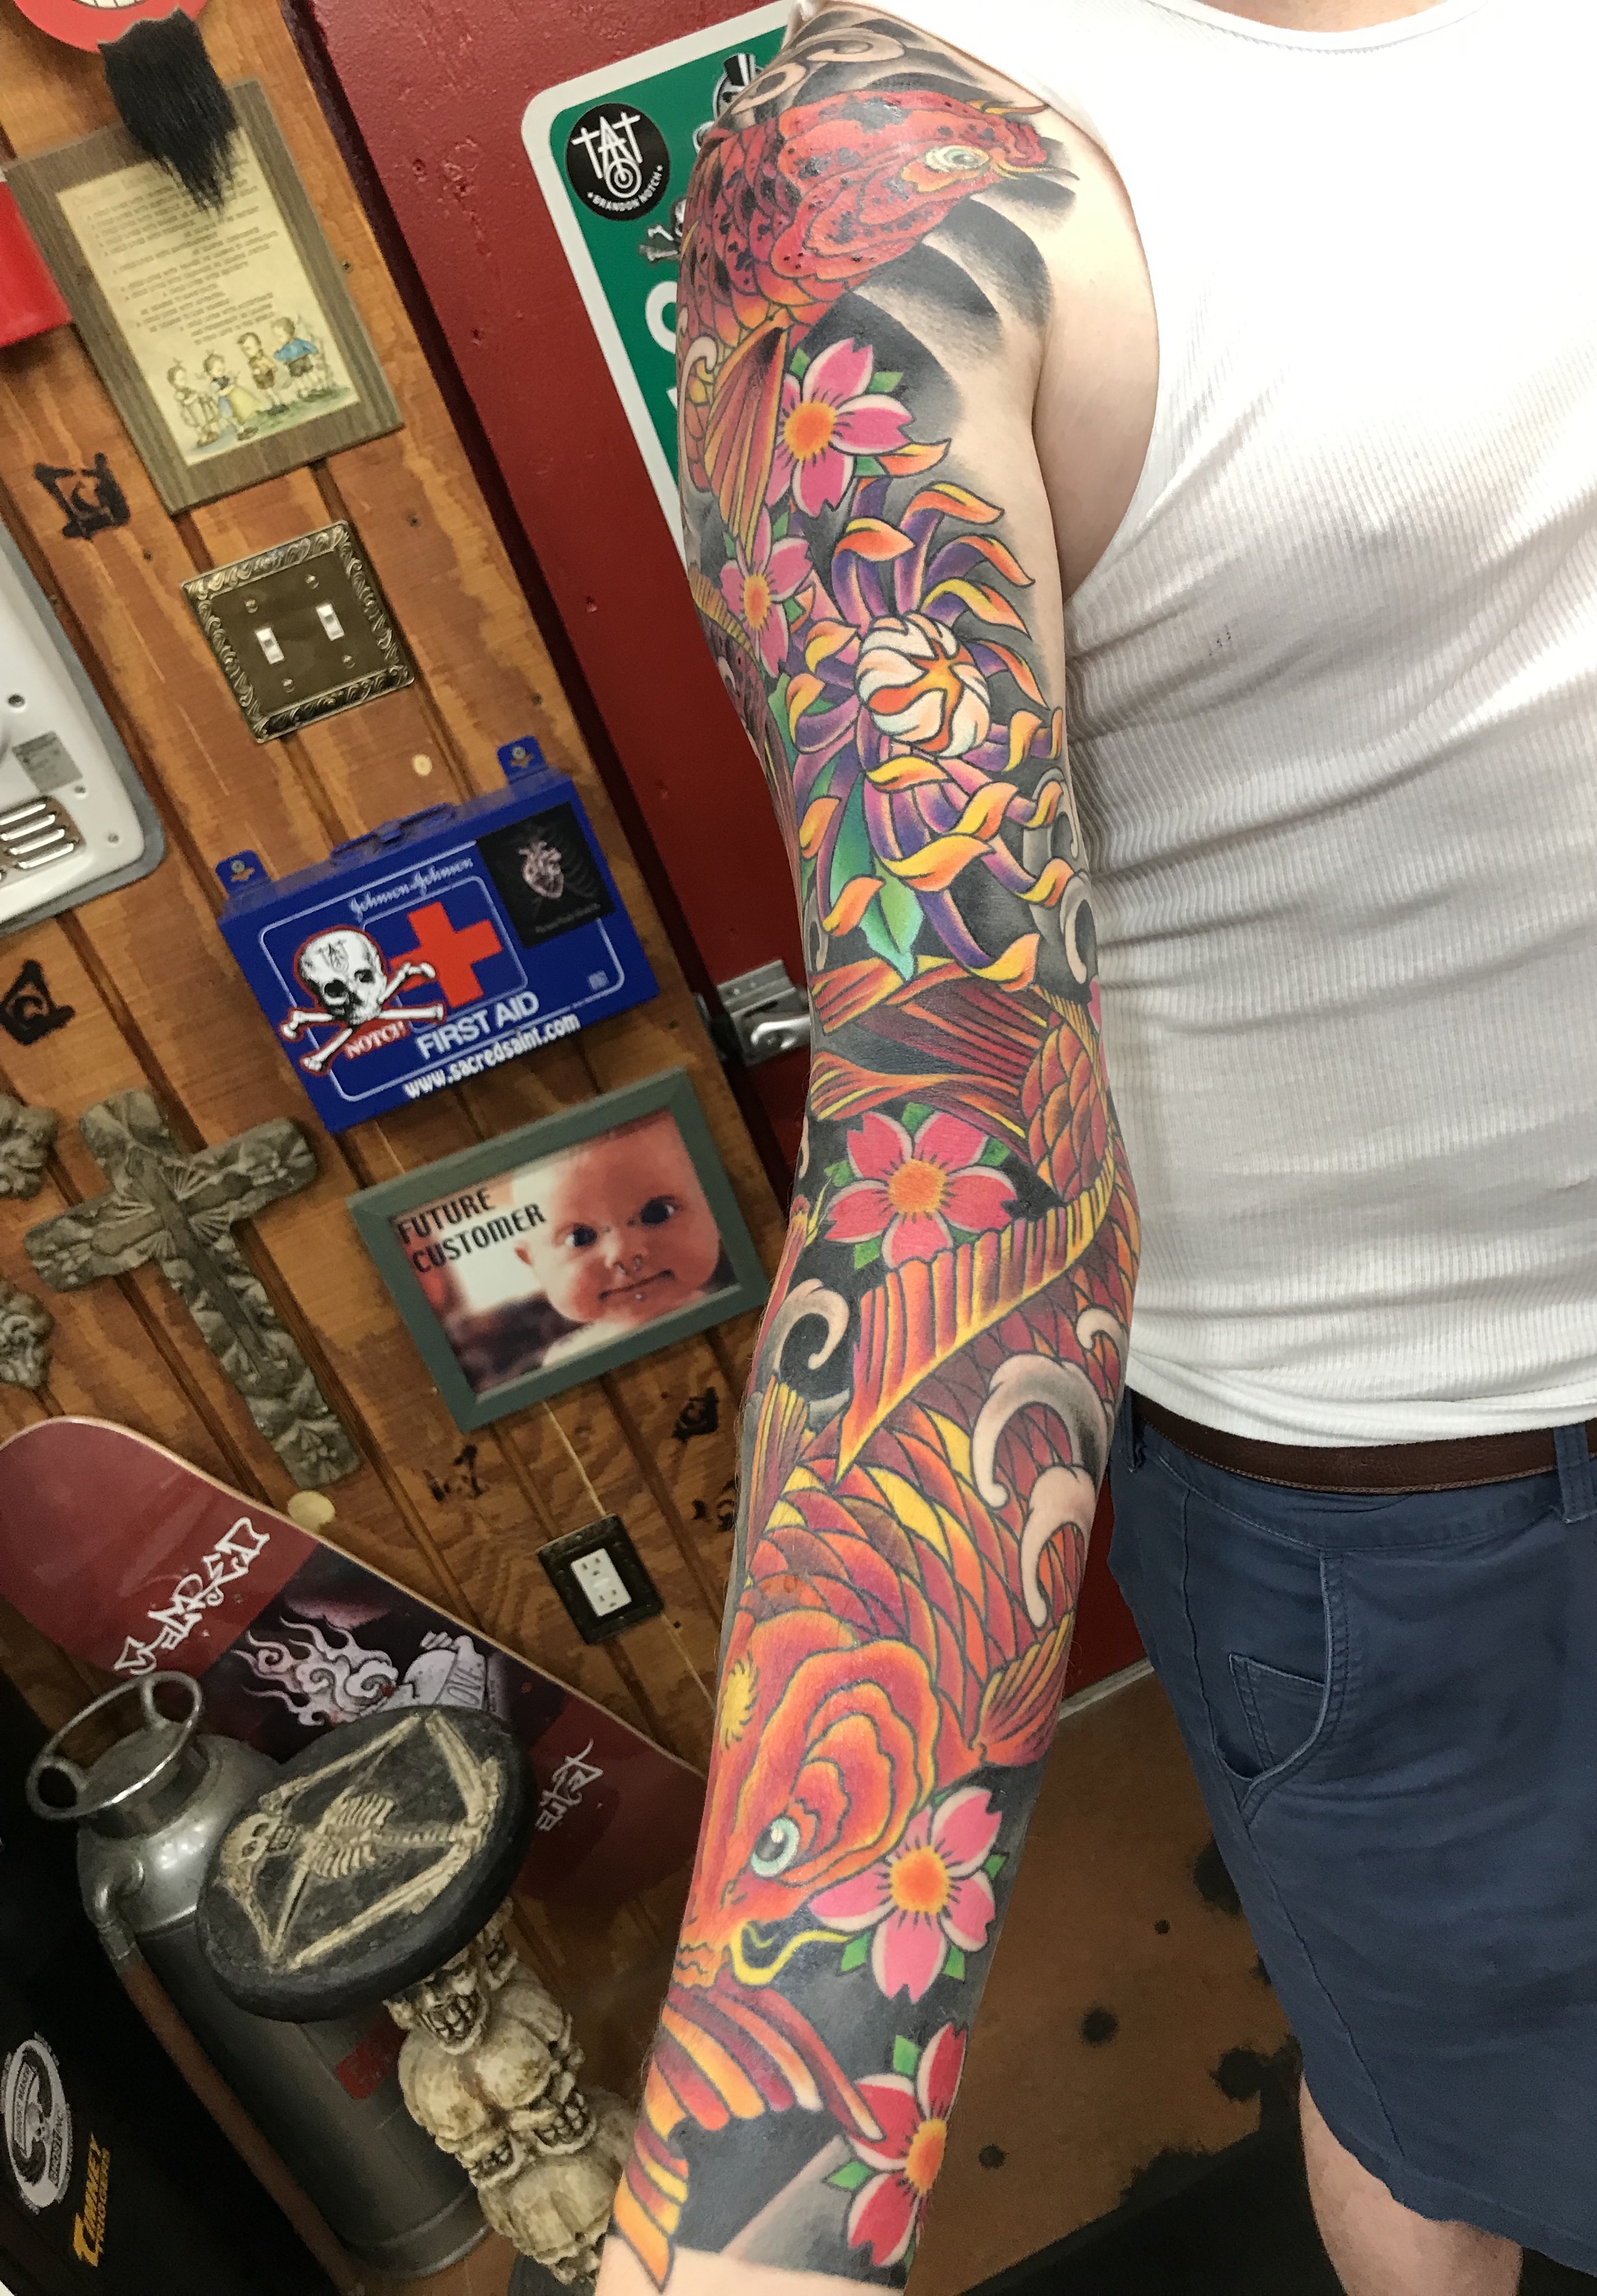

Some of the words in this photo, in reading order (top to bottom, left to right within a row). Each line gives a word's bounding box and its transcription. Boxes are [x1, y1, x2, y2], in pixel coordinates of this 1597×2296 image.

[402, 1013, 582, 1100] www.sacredsaint.com
[416, 1009, 492, 1060] FIRST
[494, 990, 540, 1029] AID
[398, 1187, 496, 1244] FUTURE
[412, 1203, 547, 1273] CUSTOMER
